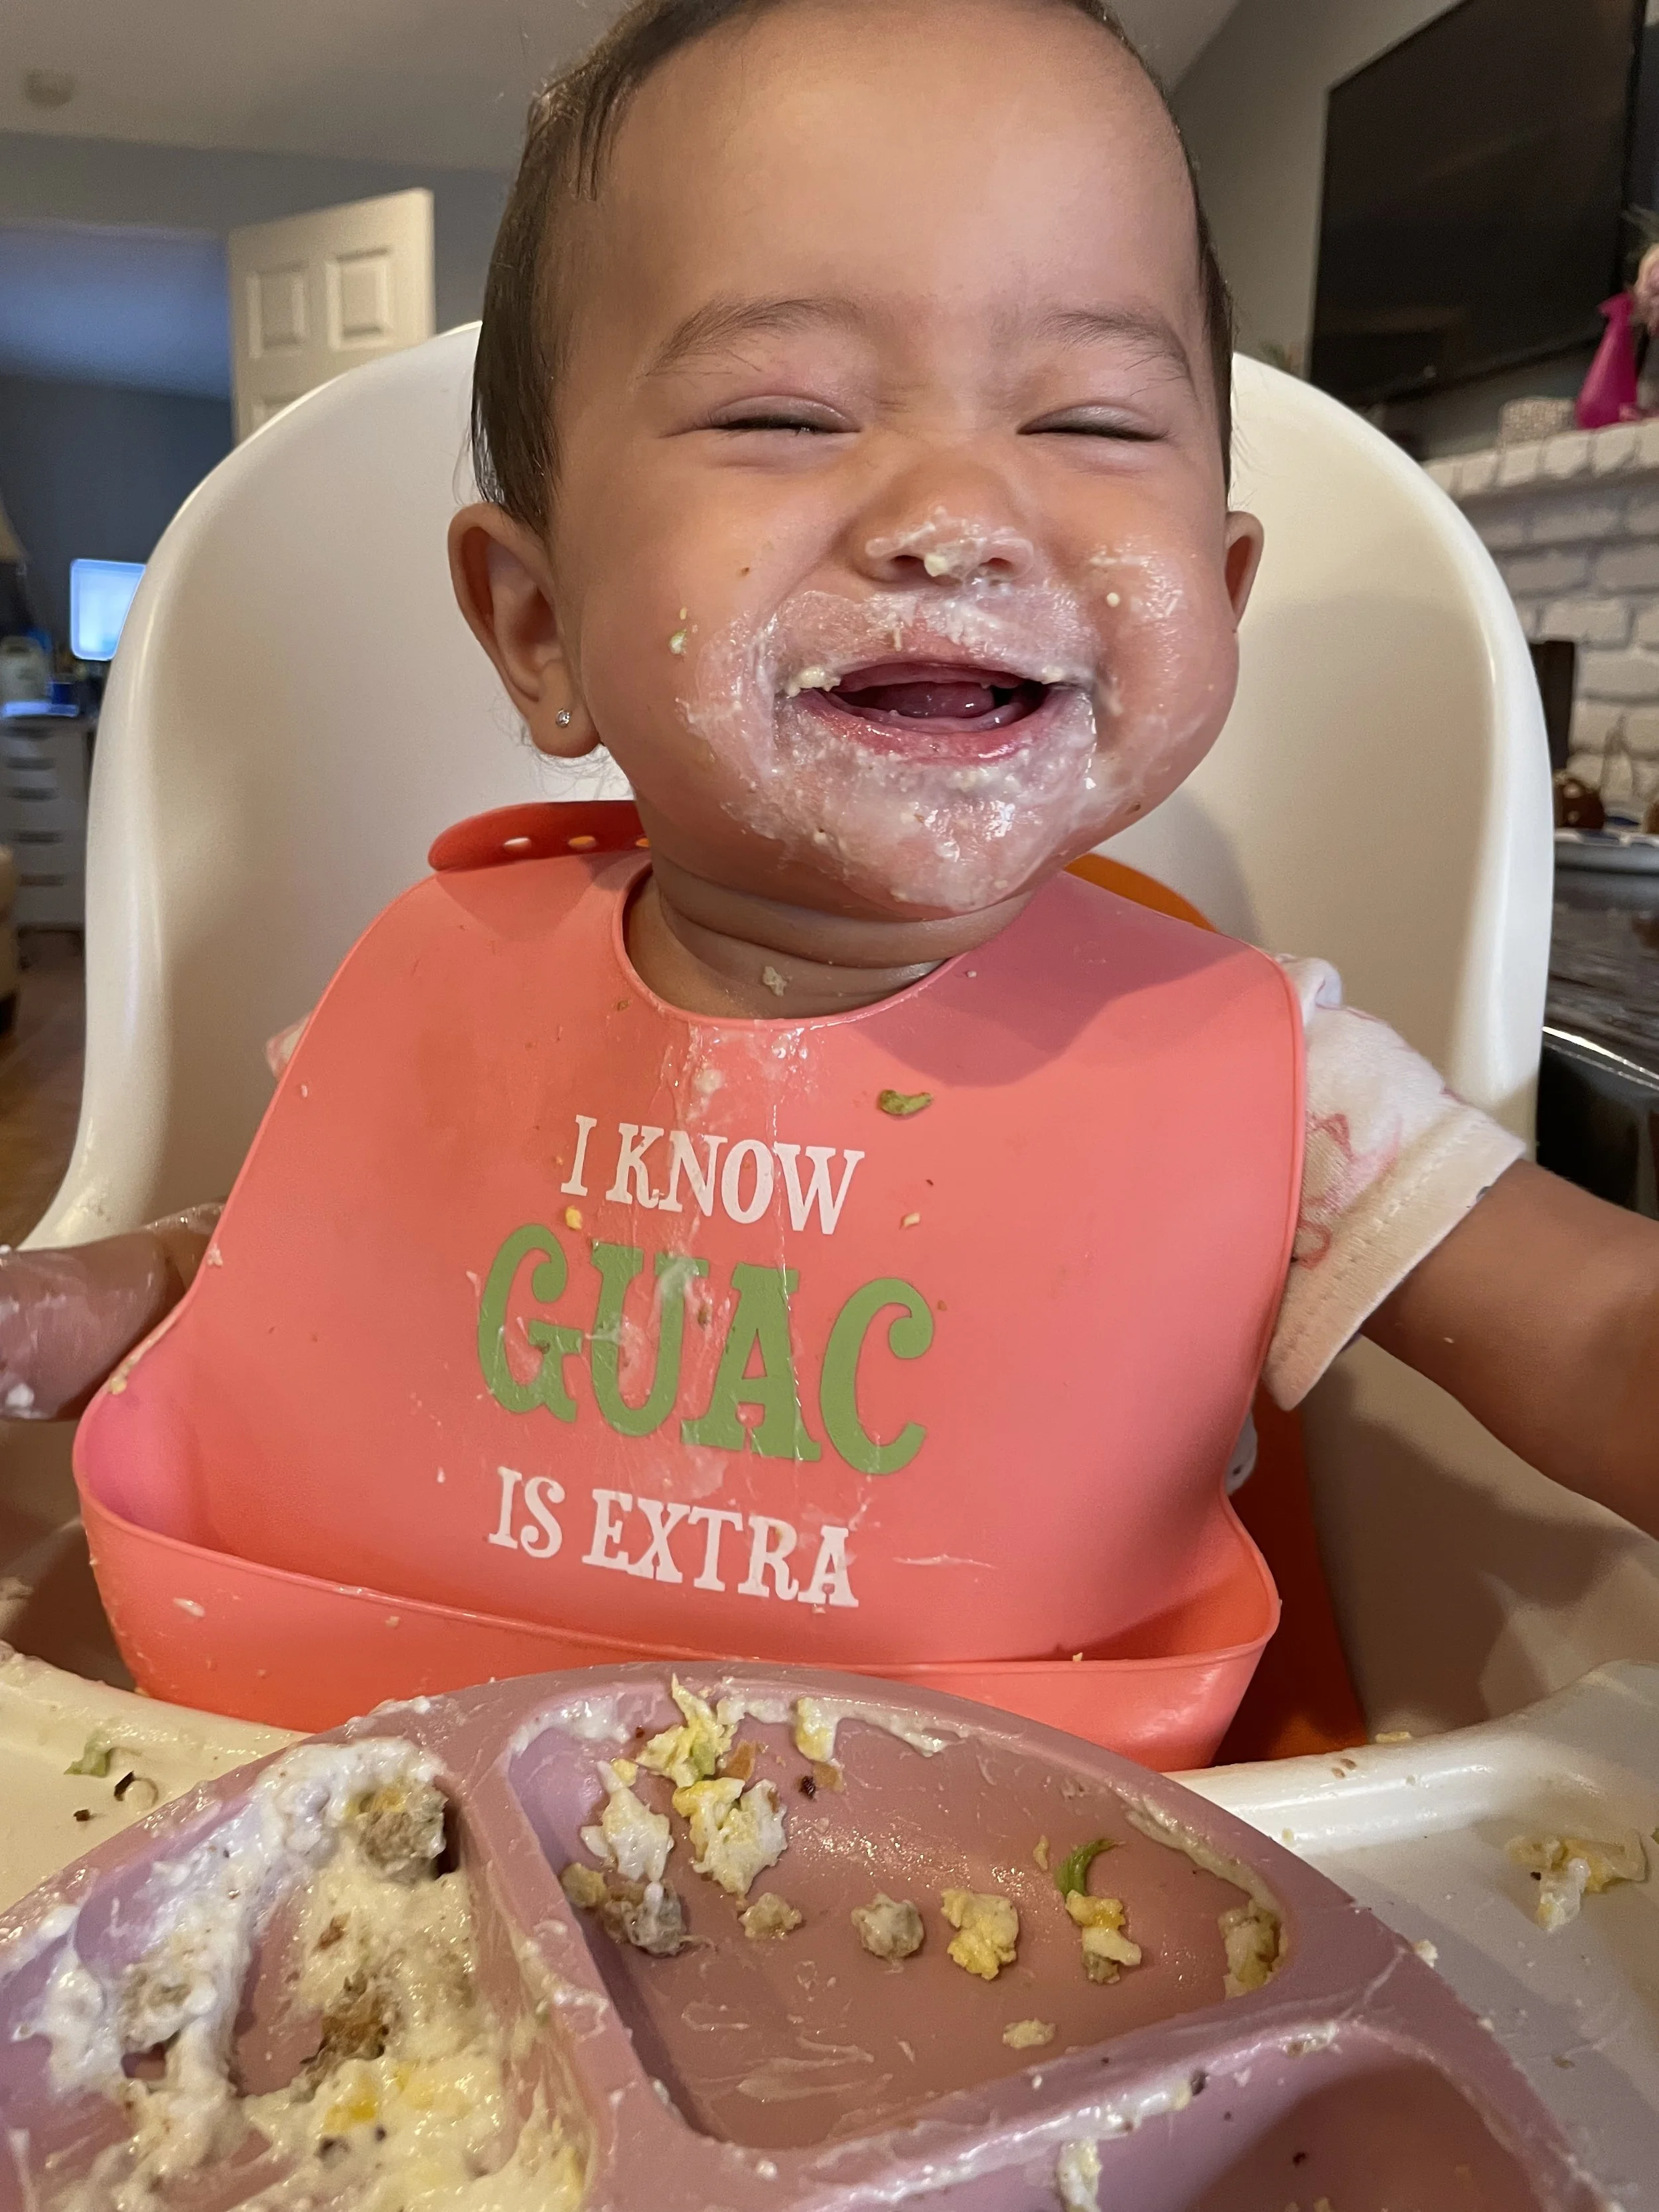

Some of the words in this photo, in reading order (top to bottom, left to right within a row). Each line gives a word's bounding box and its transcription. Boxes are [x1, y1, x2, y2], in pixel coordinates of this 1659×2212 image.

[561, 1115, 597, 1196] I
[607, 1123, 865, 1234] KNOW
[477, 1224, 934, 1475] GUAC
[488, 1467, 565, 1558] IS
[583, 1489, 859, 1607] EXTRA
